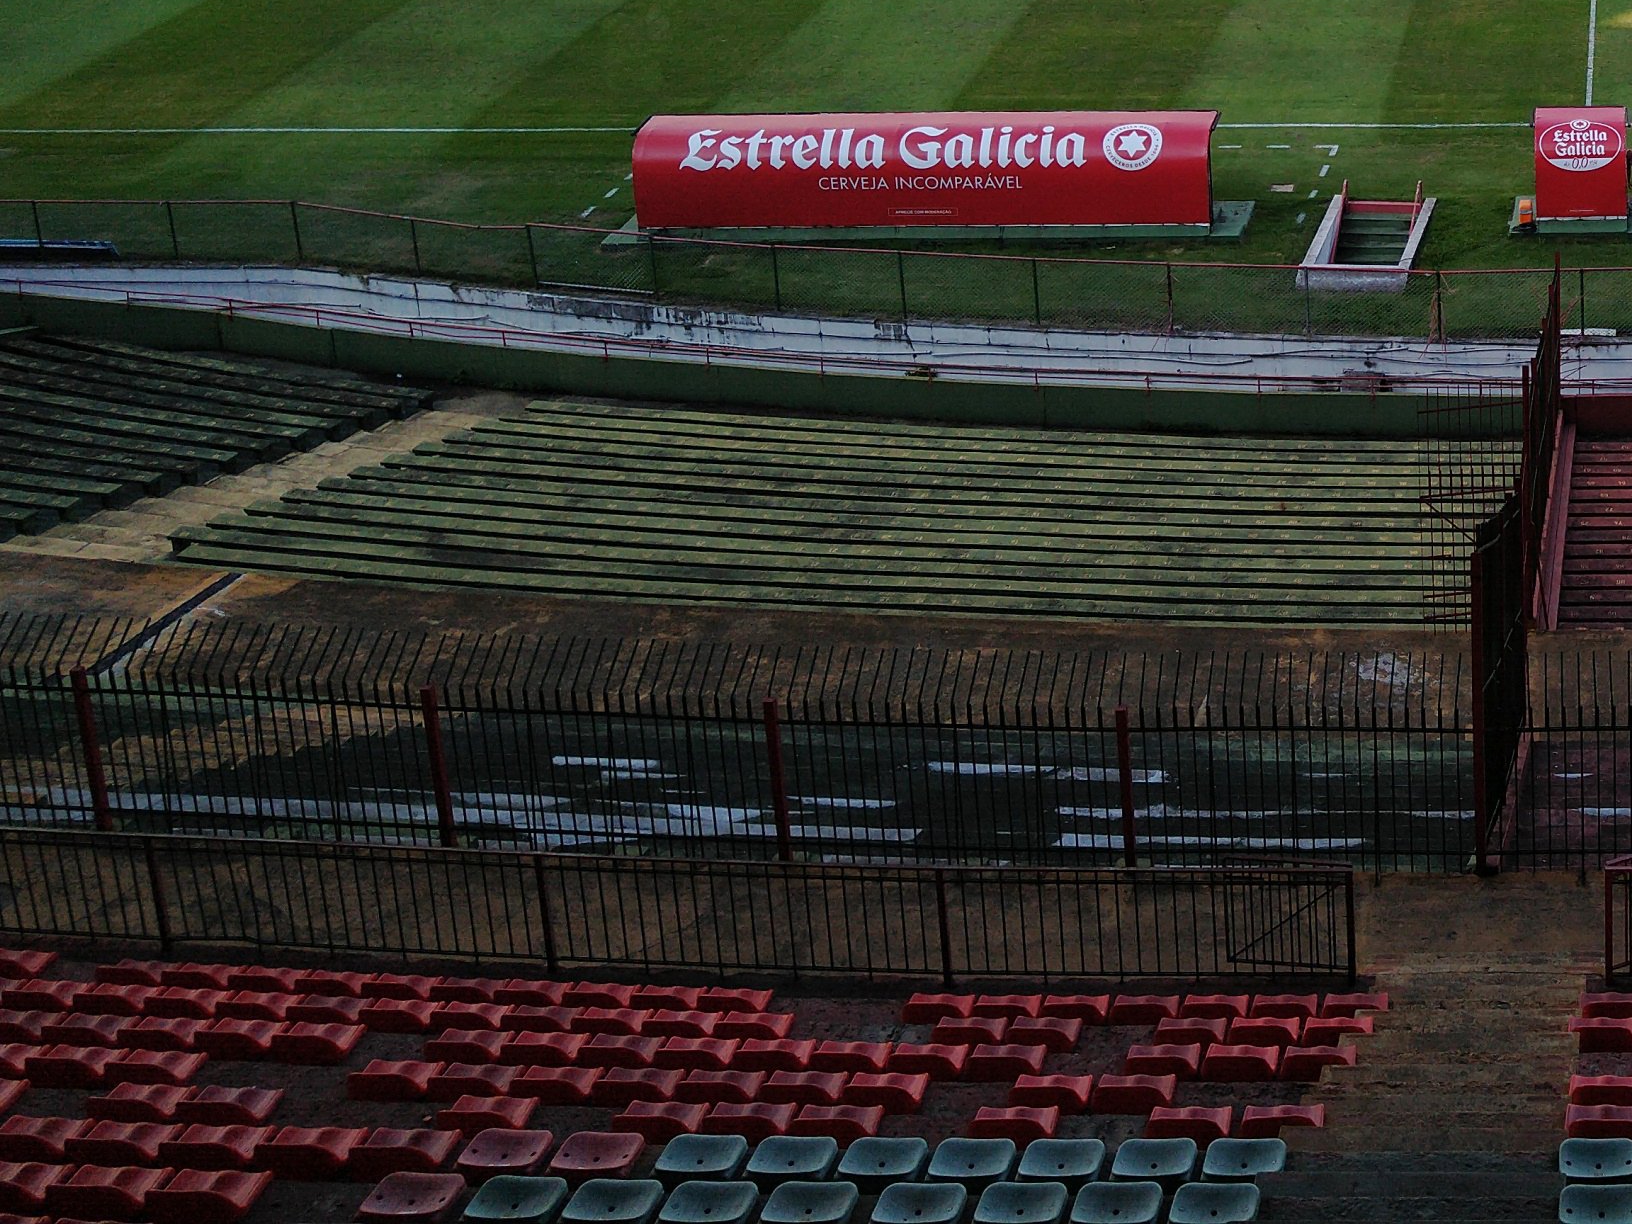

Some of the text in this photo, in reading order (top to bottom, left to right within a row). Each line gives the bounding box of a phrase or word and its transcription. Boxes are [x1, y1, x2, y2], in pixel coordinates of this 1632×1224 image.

[1553, 130, 1608, 142] Estrella
[679, 125, 1087, 172] Estrella Galicia
[1555, 141, 1605, 156] Galicia
[818, 173, 1023, 190] CERVEJA INCOMPARÁVEL
